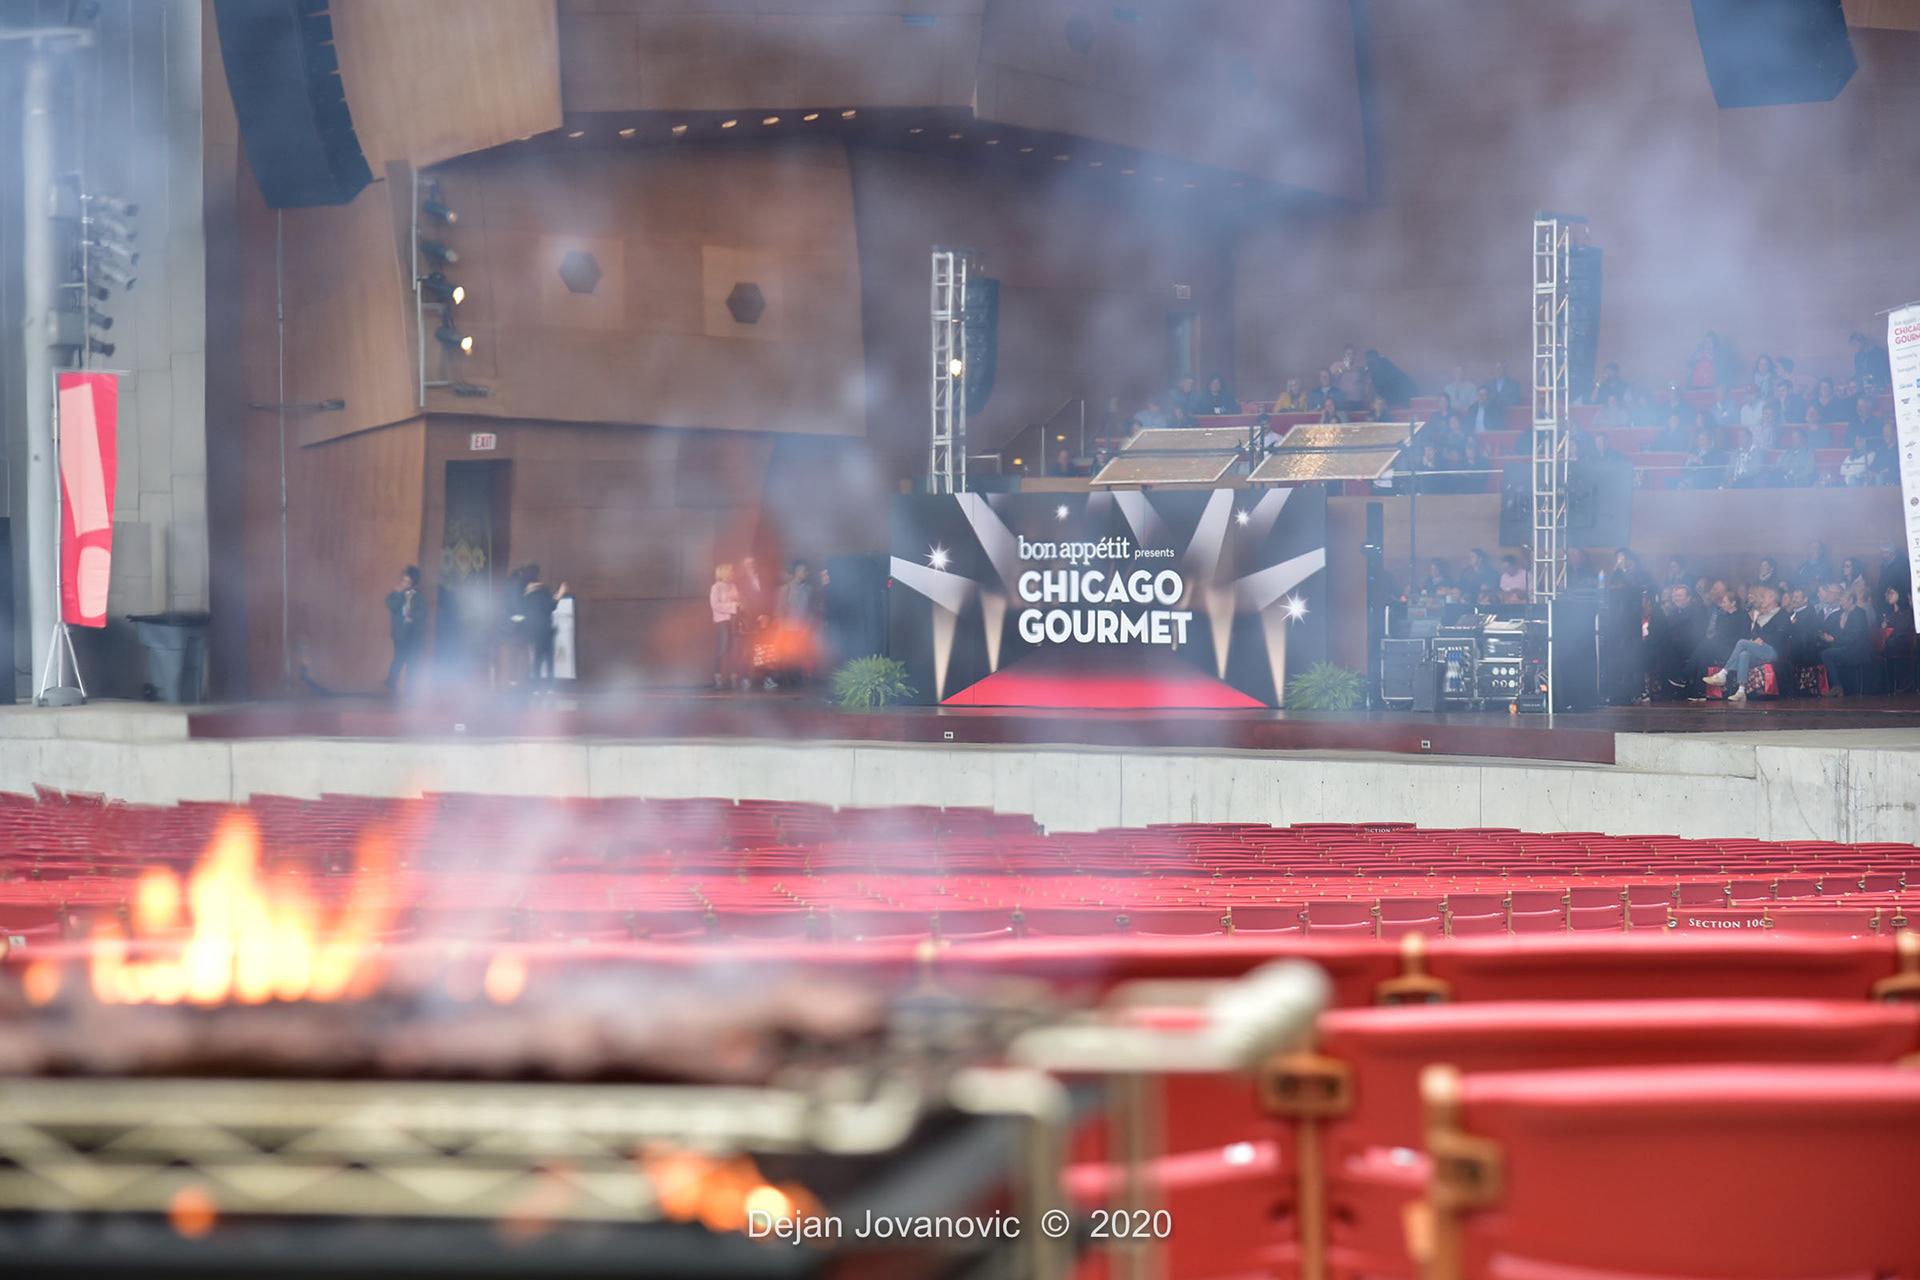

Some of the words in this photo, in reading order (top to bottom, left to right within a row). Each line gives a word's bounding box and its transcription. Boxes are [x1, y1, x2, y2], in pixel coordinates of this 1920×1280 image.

[474, 435, 493, 449] EXIT
[1018, 535, 1058, 560] bon
[1060, 536, 1130, 565] appétit
[1134, 548, 1175, 560] presents
[1018, 570, 1183, 605] CHICAGO
[1018, 609, 1193, 644] GOURMET
[1689, 918, 1741, 928] SECTION
